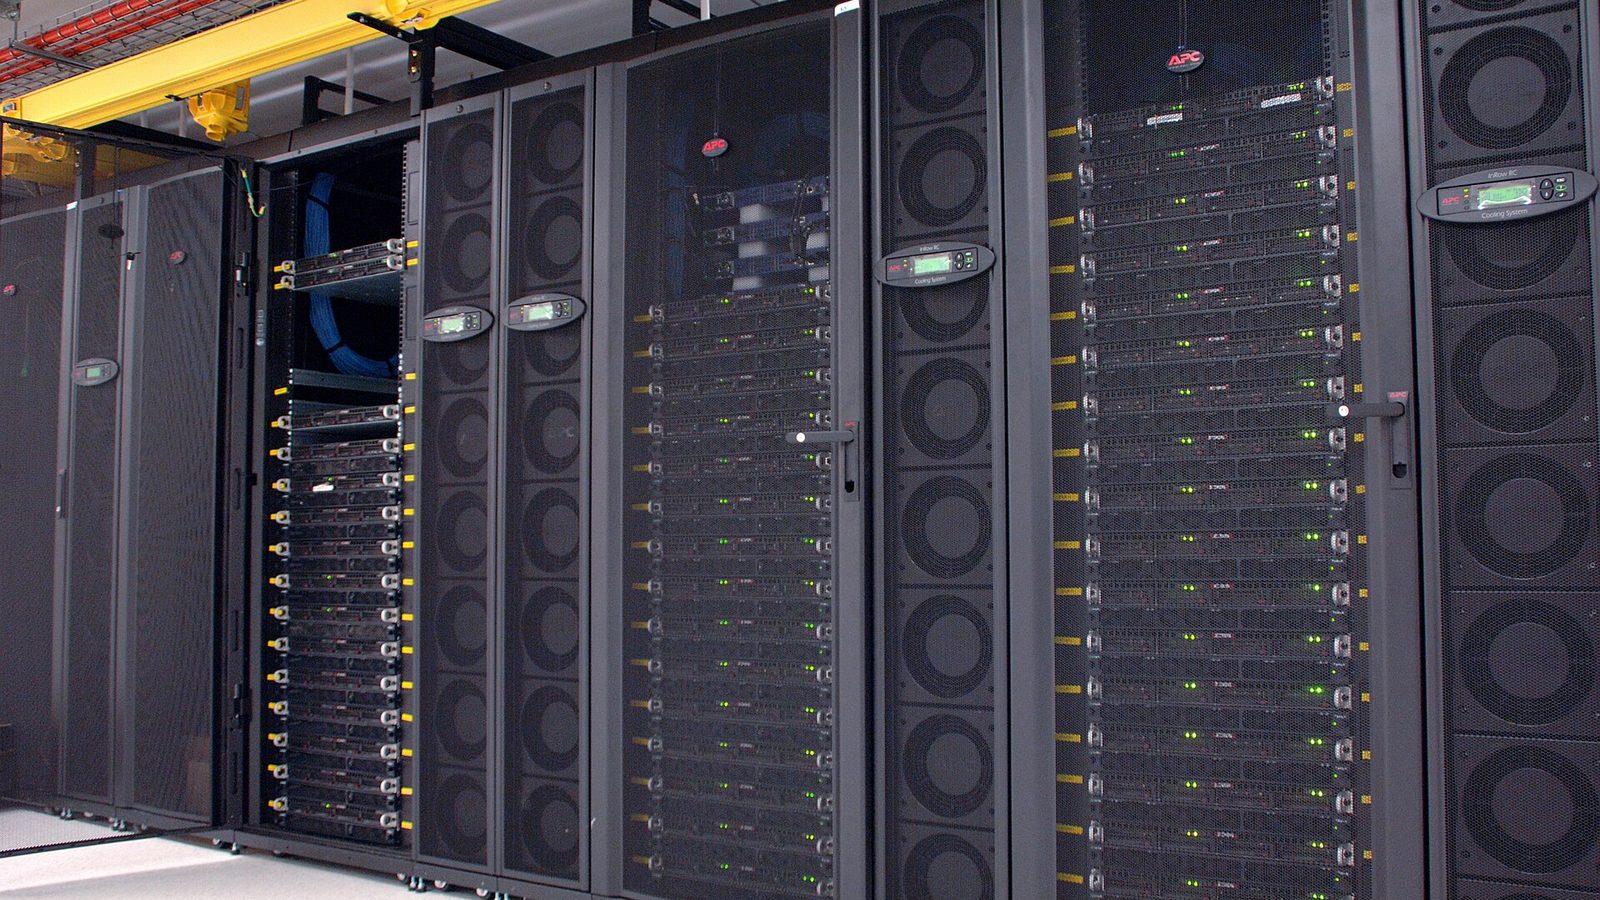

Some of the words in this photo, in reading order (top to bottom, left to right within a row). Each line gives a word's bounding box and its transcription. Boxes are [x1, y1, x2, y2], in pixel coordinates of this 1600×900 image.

[1168, 51, 1201, 66] APC
[704, 138, 726, 151] APC
[1481, 210, 1505, 219] Cooling
[1506, 208, 1528, 216] System
